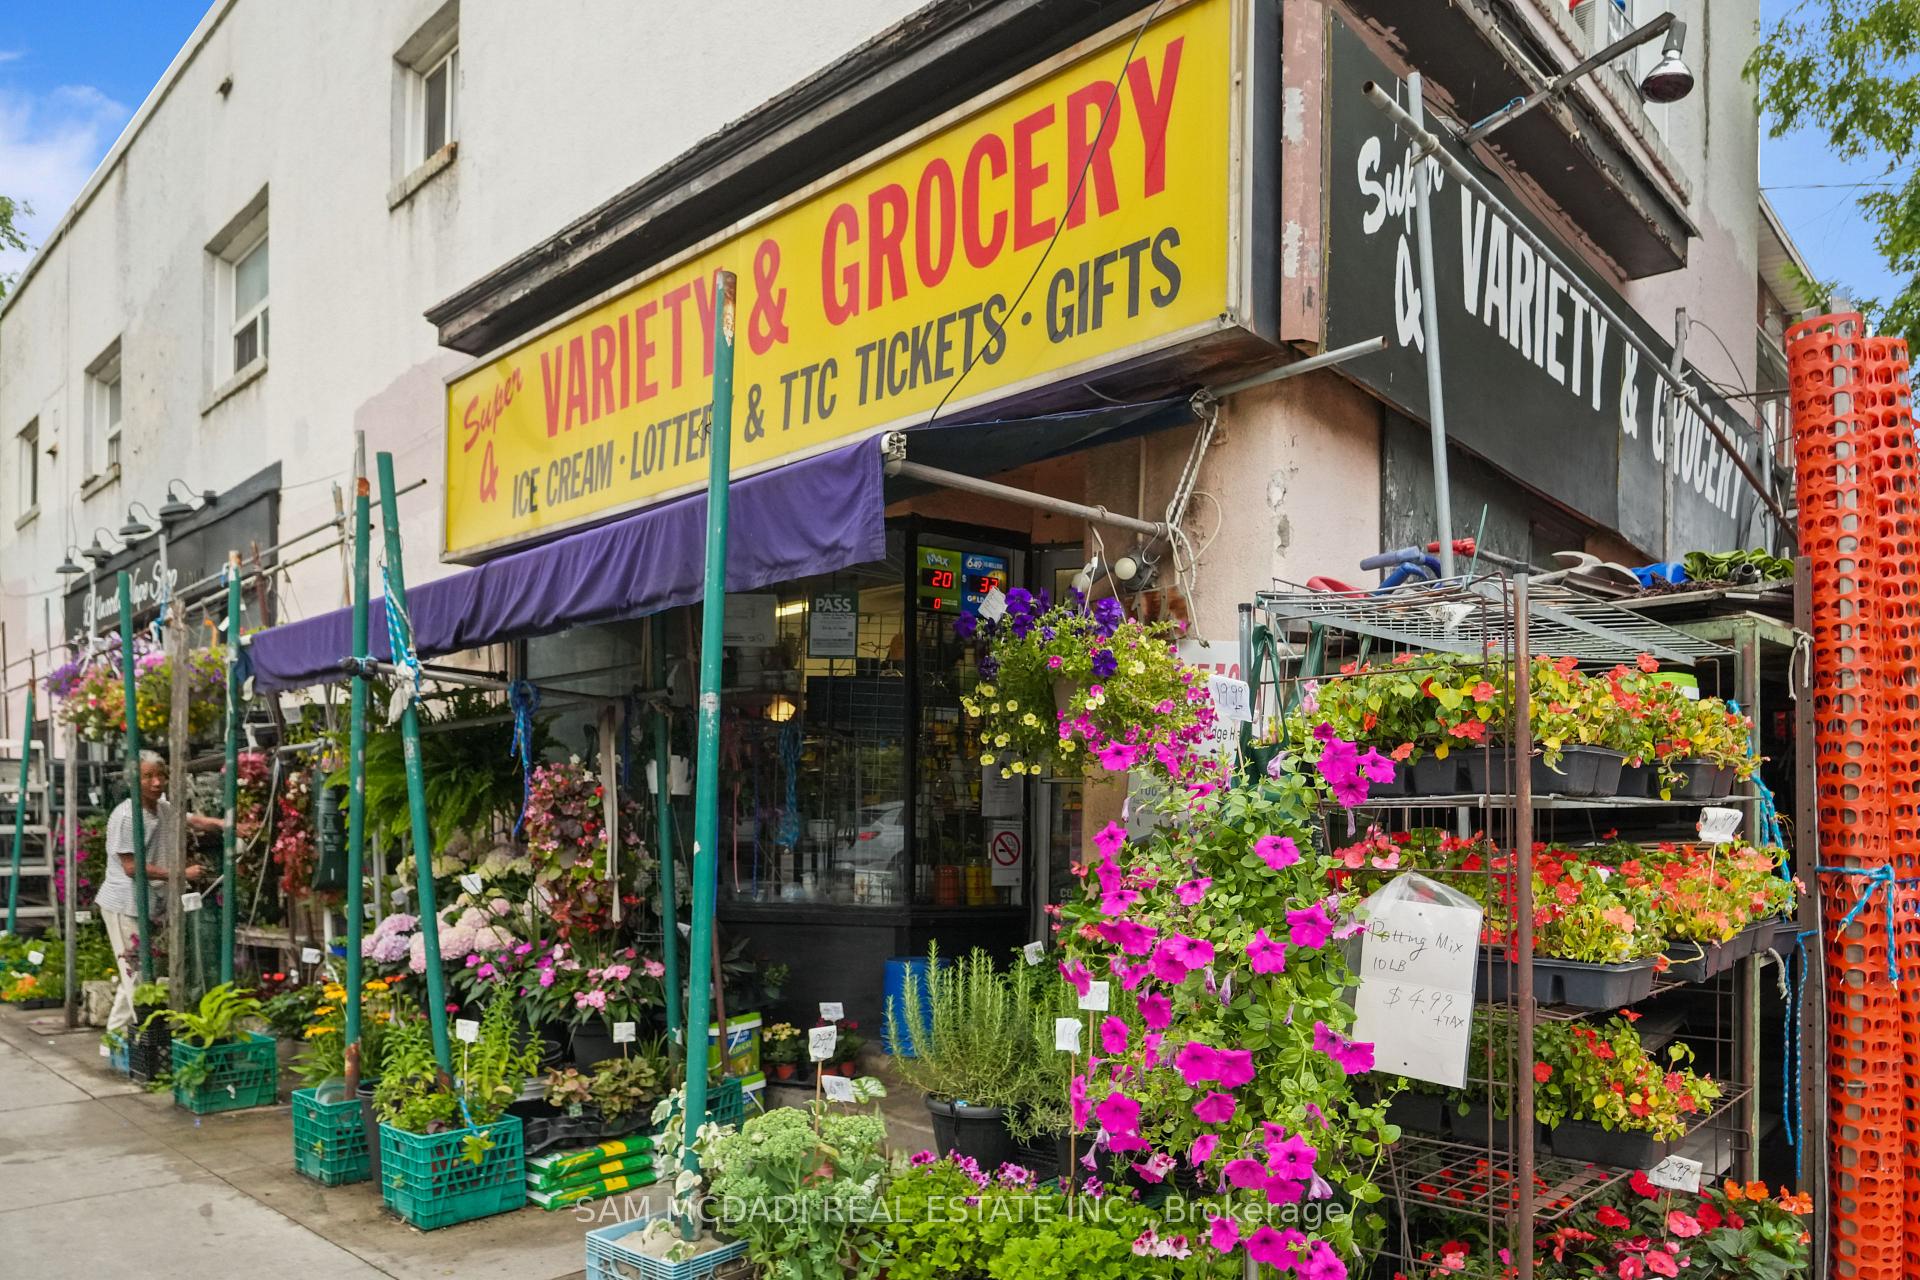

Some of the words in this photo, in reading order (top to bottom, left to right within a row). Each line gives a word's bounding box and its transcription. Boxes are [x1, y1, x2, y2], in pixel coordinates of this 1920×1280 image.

[747, 238, 789, 356] &
[821, 36, 1185, 326] GROCERY
[1358, 136, 1444, 235] Supr
[1461, 184, 1608, 412] VARIETY
[1620, 341, 1639, 440] &
[464, 367, 523, 453] Super
[512, 466, 541, 519] ICE
[546, 439, 614, 508] CREAM
[630, 394, 733, 481] LOTTER
[744, 383, 765, 443] &
[779, 357, 837, 431] TTC
[855, 293, 1007, 406] TICKETS
[1046, 226, 1182, 344] GIFTS
[815, 597, 852, 612] PASS
[931, 569, 954, 589] 20
[1435, 932, 1464, 953] Mix
